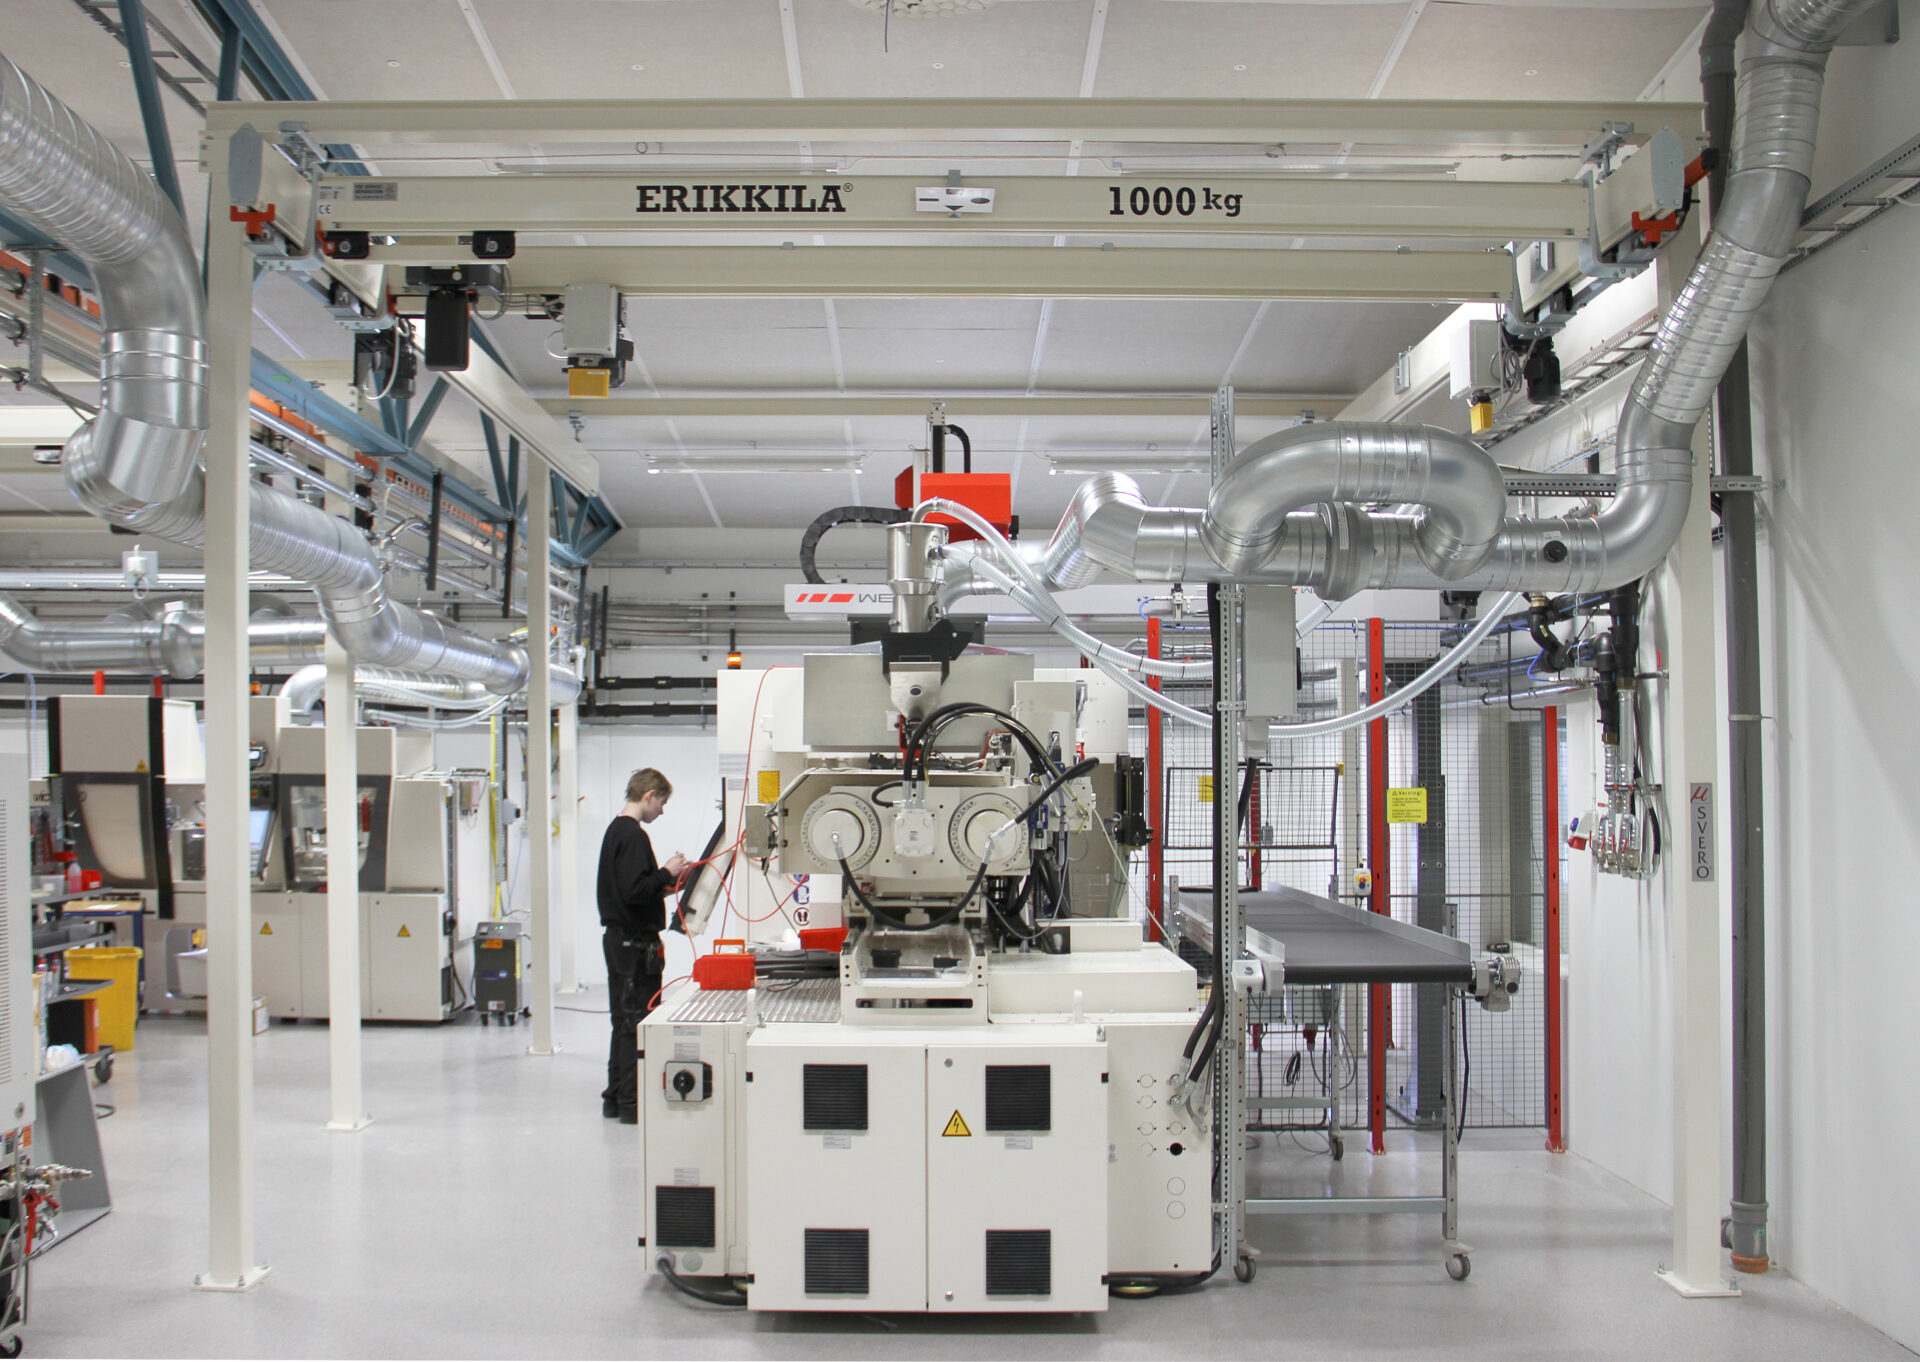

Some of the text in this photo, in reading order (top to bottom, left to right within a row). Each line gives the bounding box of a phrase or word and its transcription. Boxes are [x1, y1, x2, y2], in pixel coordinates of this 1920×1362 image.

[1109, 187, 1243, 217] 1000 kg
[1696, 806, 1710, 879] SVERO
